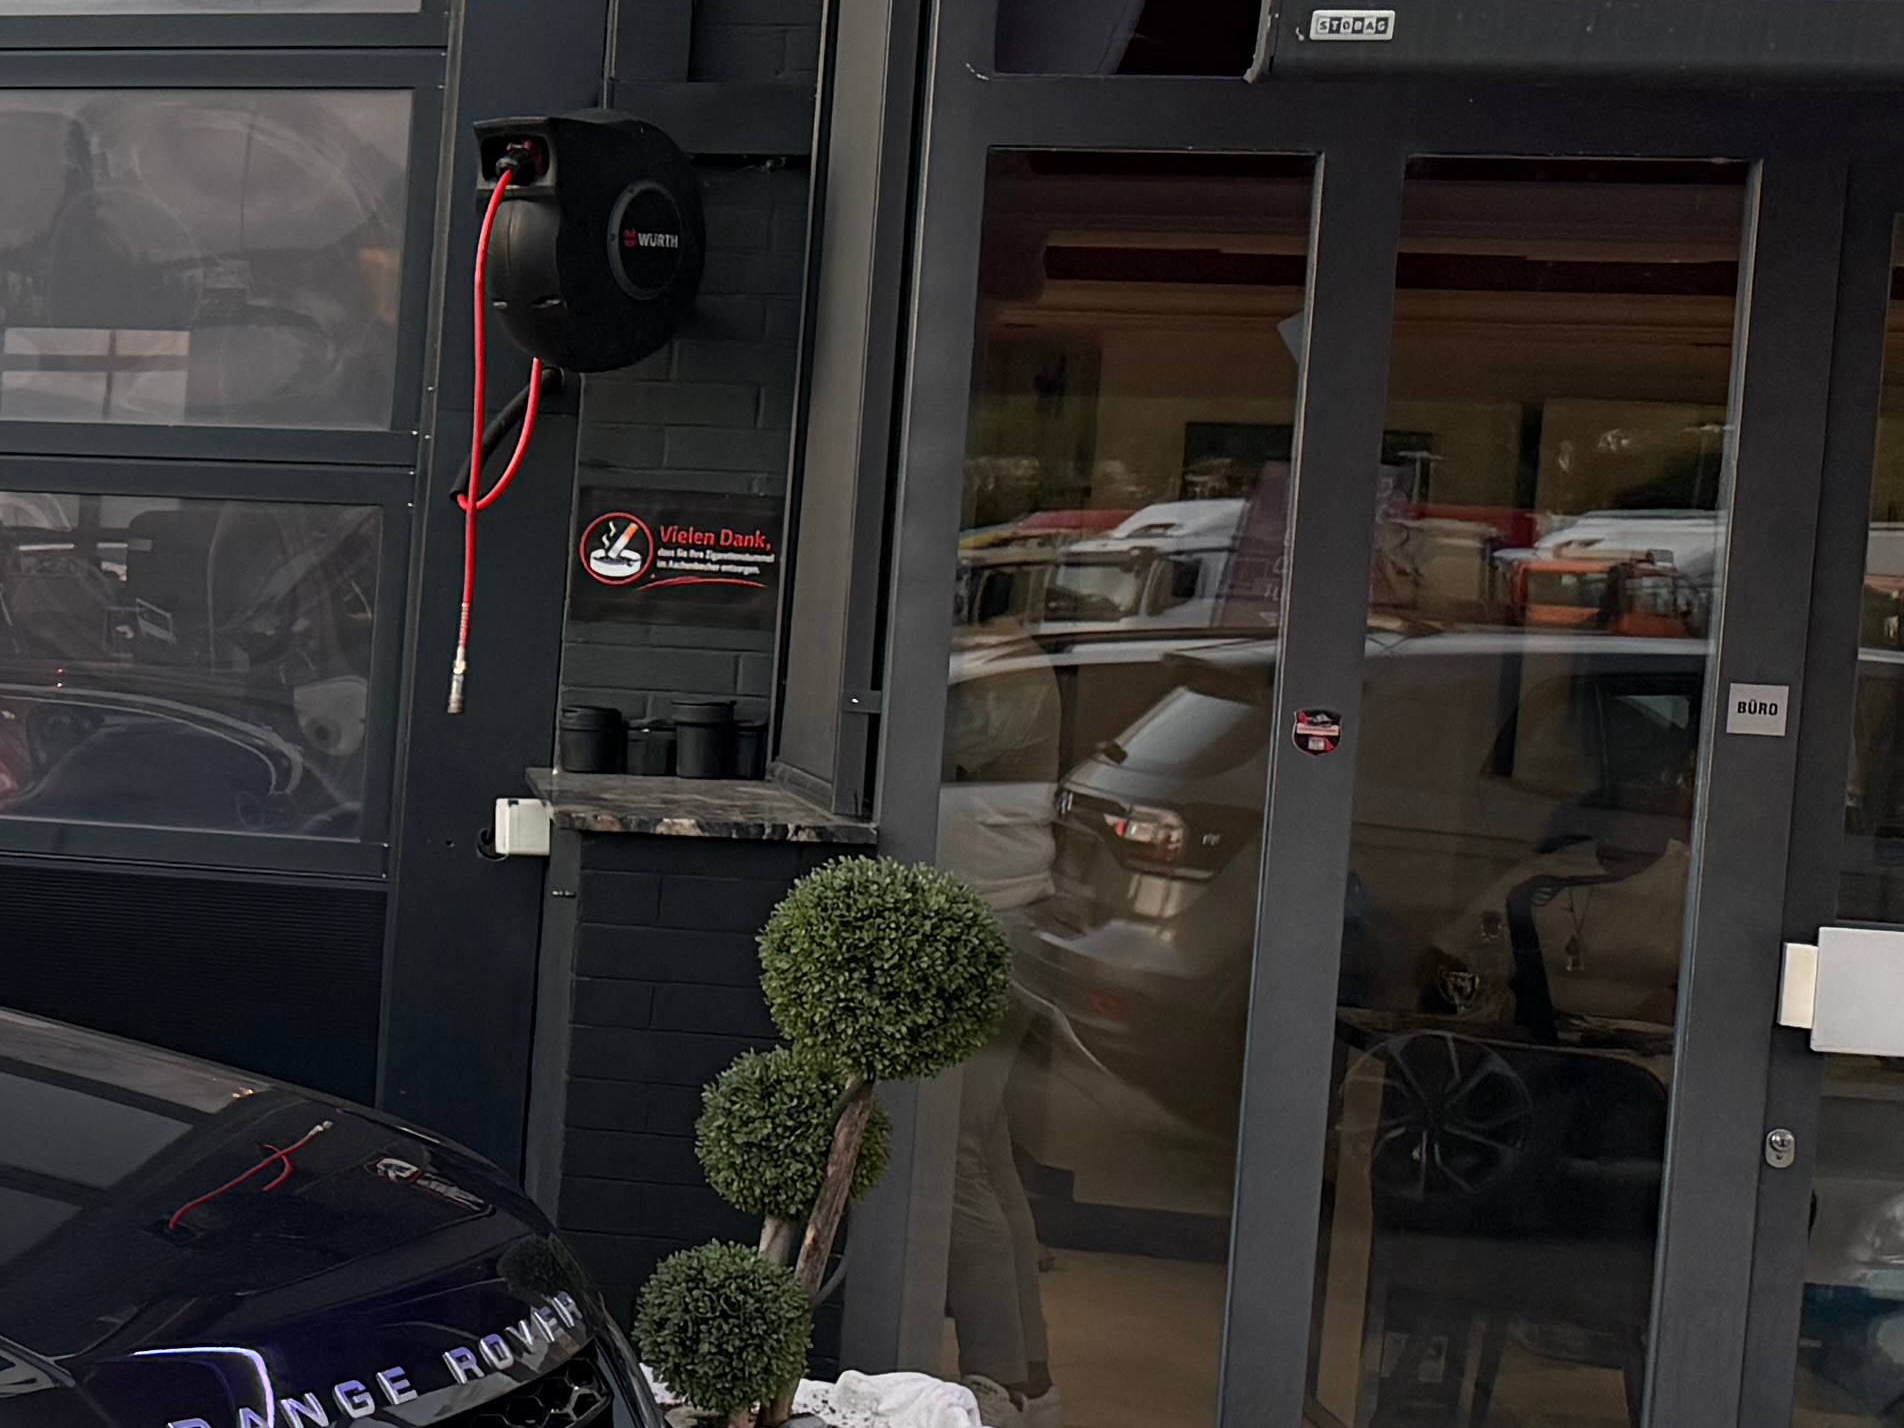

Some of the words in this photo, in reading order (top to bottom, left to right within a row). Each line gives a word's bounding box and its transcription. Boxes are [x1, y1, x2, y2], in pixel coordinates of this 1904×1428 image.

[1318, 19, 1387, 32] STOBAG
[660, 525, 716, 545] Vielen
[720, 529, 772, 551] Dank,
[1737, 698, 1778, 716] BÜRO
[443, 1291, 583, 1384] ROVER
